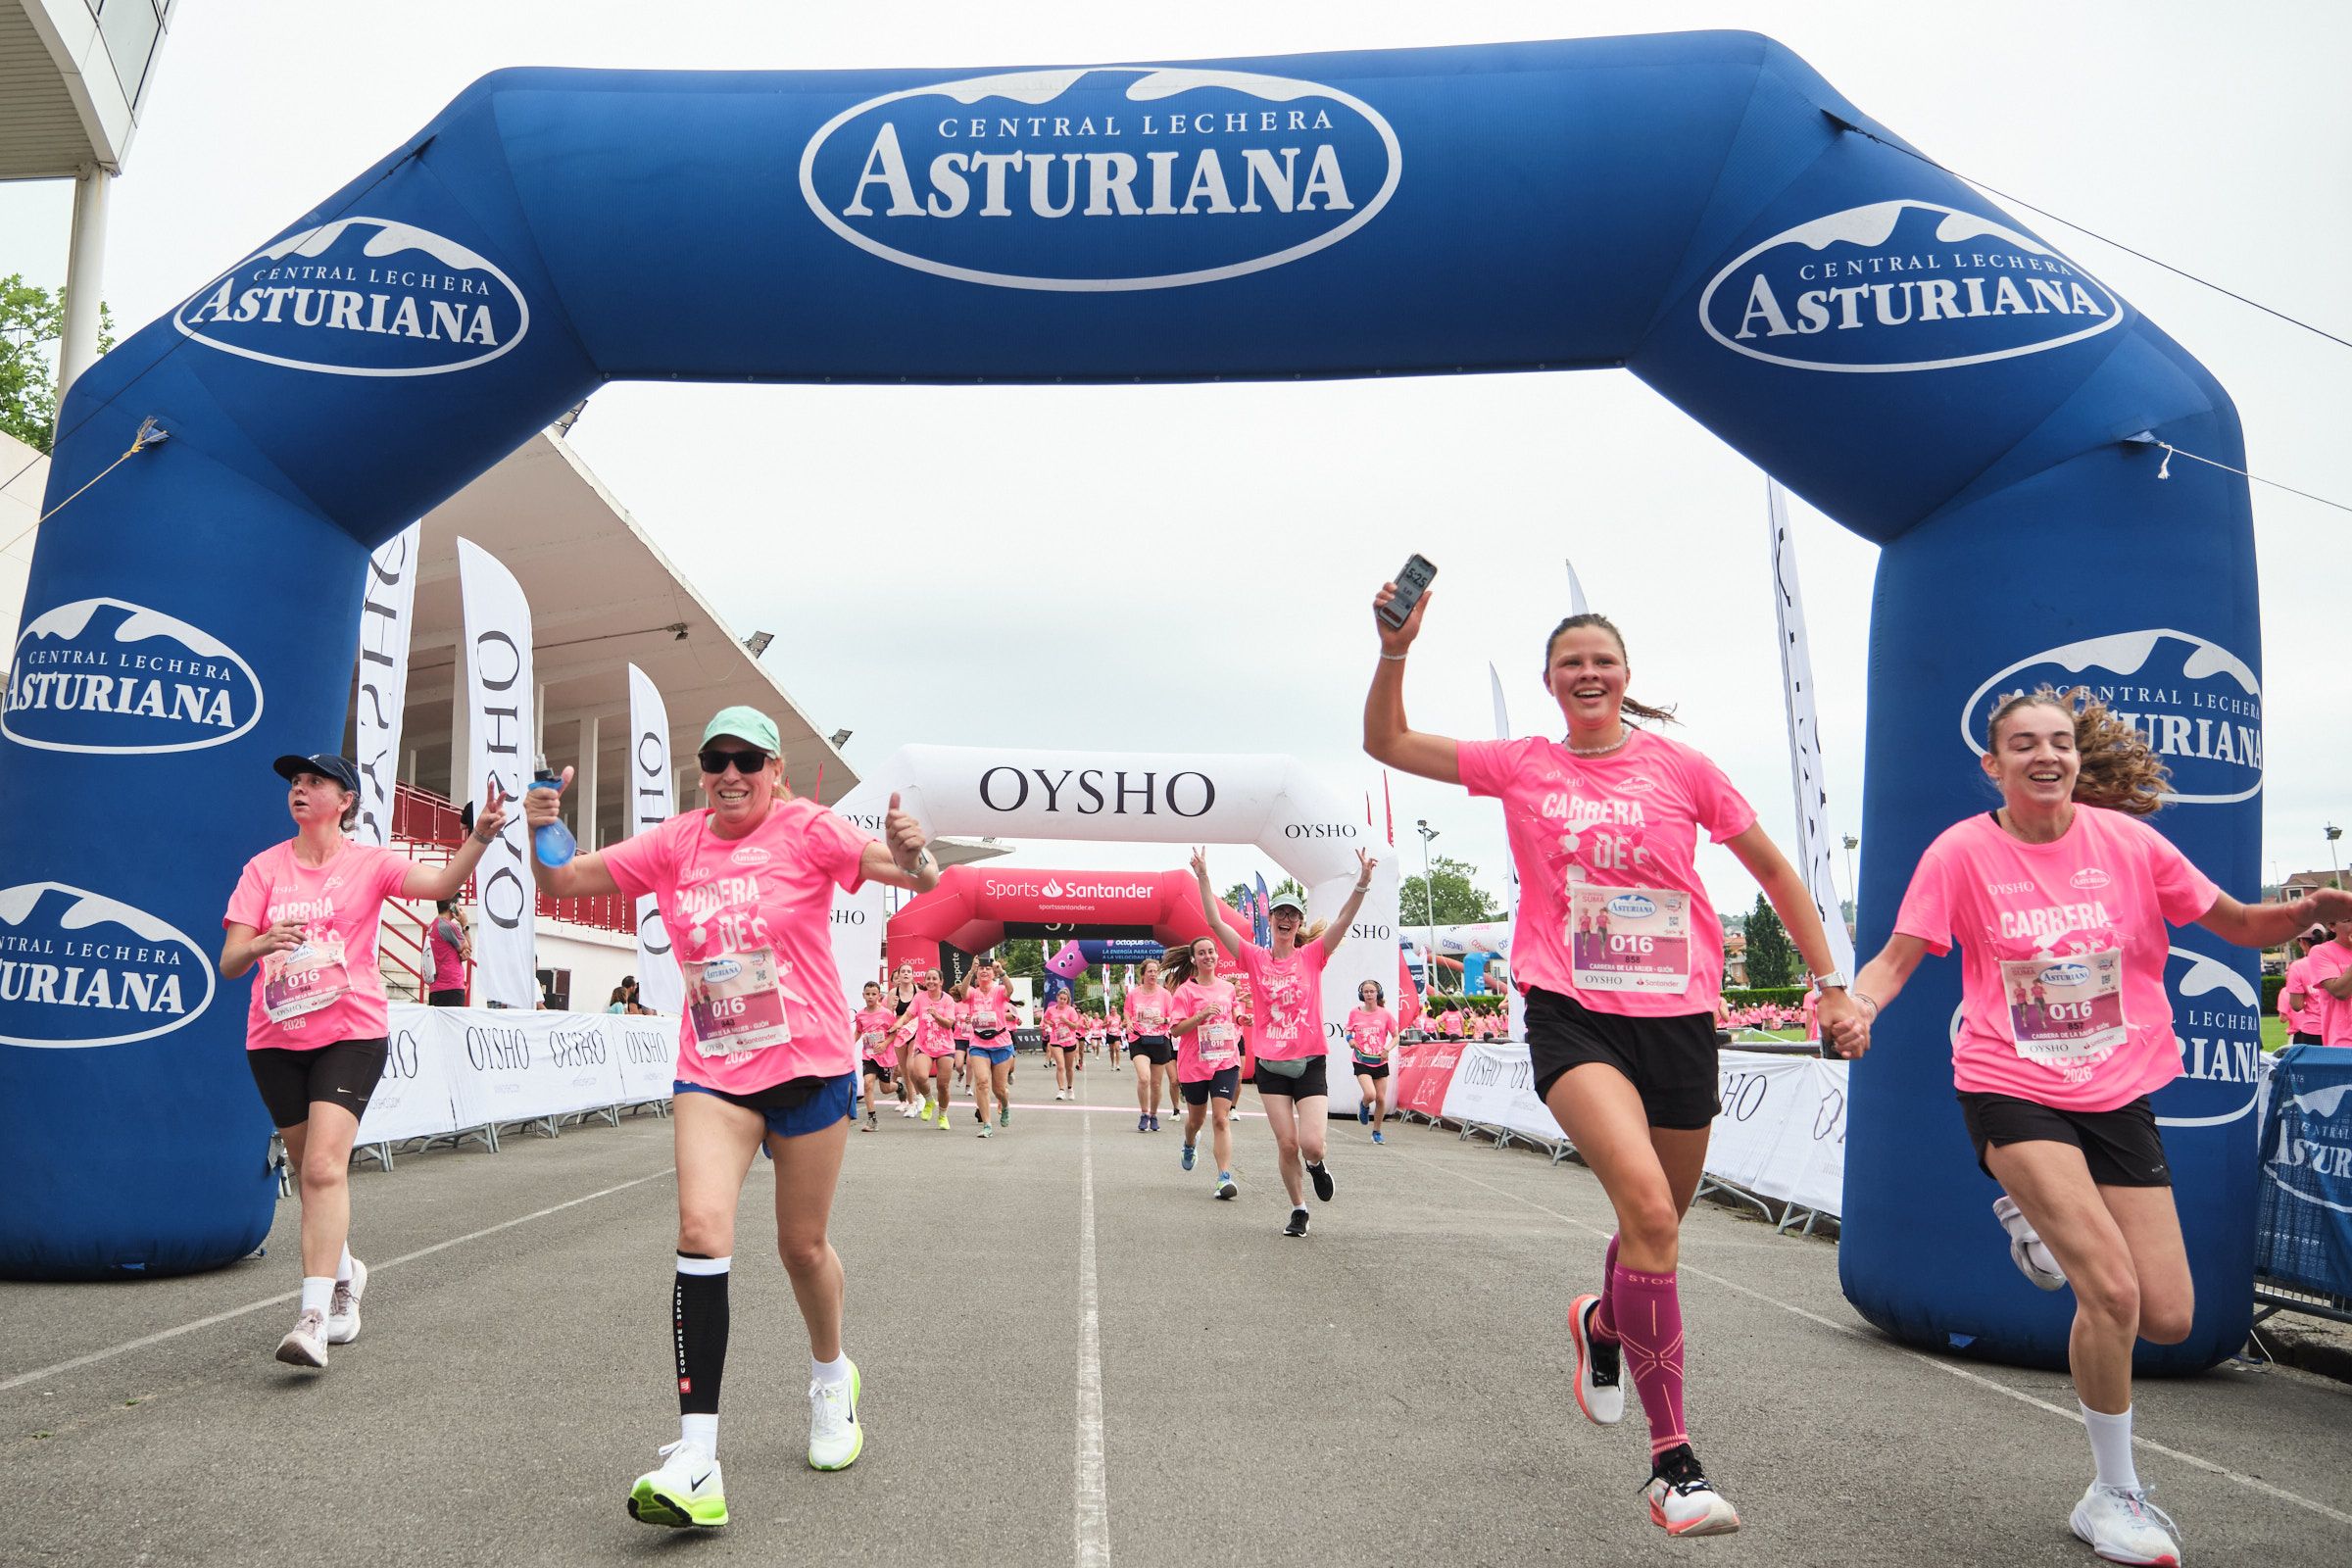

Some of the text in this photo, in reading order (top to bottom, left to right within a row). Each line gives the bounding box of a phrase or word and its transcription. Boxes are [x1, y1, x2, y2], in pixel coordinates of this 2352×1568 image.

[938, 108, 1334, 138] CENTRAL LECHERA
[842, 121, 1354, 220] ASTURIANA
[1799, 252, 2073, 281] CENTRAL LECHERA
[253, 268, 490, 296] CENTRAL LECHERA
[188, 277, 498, 347] ASTURIANA
[1735, 273, 2108, 342] ASTURIANA
[28, 650, 231, 681] CENTRAL LECHERA
[3, 657, 236, 728] ASTURIANA
[2193, 691, 2261, 720] LECHERA
[980, 765, 1216, 817] OYSHO
[1542, 791, 1646, 829] CARRERA
[1285, 823, 1357, 839] OYSHO
[1593, 832, 1630, 870] DE
[986, 879, 1153, 900] Sports Santander
[1987, 880, 2034, 896] OYSHO
[1611, 903, 1653, 912] ASTURIANA
[1999, 900, 2112, 940] CARRERA
[718, 912, 753, 954] DE
[1610, 935, 1654, 954] 016
[66, 941, 182, 965] LECHERA
[288, 969, 320, 988] 016
[1585, 974, 1623, 985] OYSHO
[712, 997, 746, 1018] 016
[2049, 1001, 2093, 1020] 016
[2189, 1009, 2258, 1032] LECHERA
[282, 1017, 306, 1031] 2026
[1265, 1024, 1298, 1040] MUJER
[466, 1026, 530, 1071] OYSHO
[550, 1029, 607, 1068] OYSHO
[625, 1031, 668, 1063] OYSHO
[2030, 1043, 2069, 1054] OYSHO
[2063, 1066, 2093, 1083] 2026
[1628, 1274, 1675, 1285] STOX
